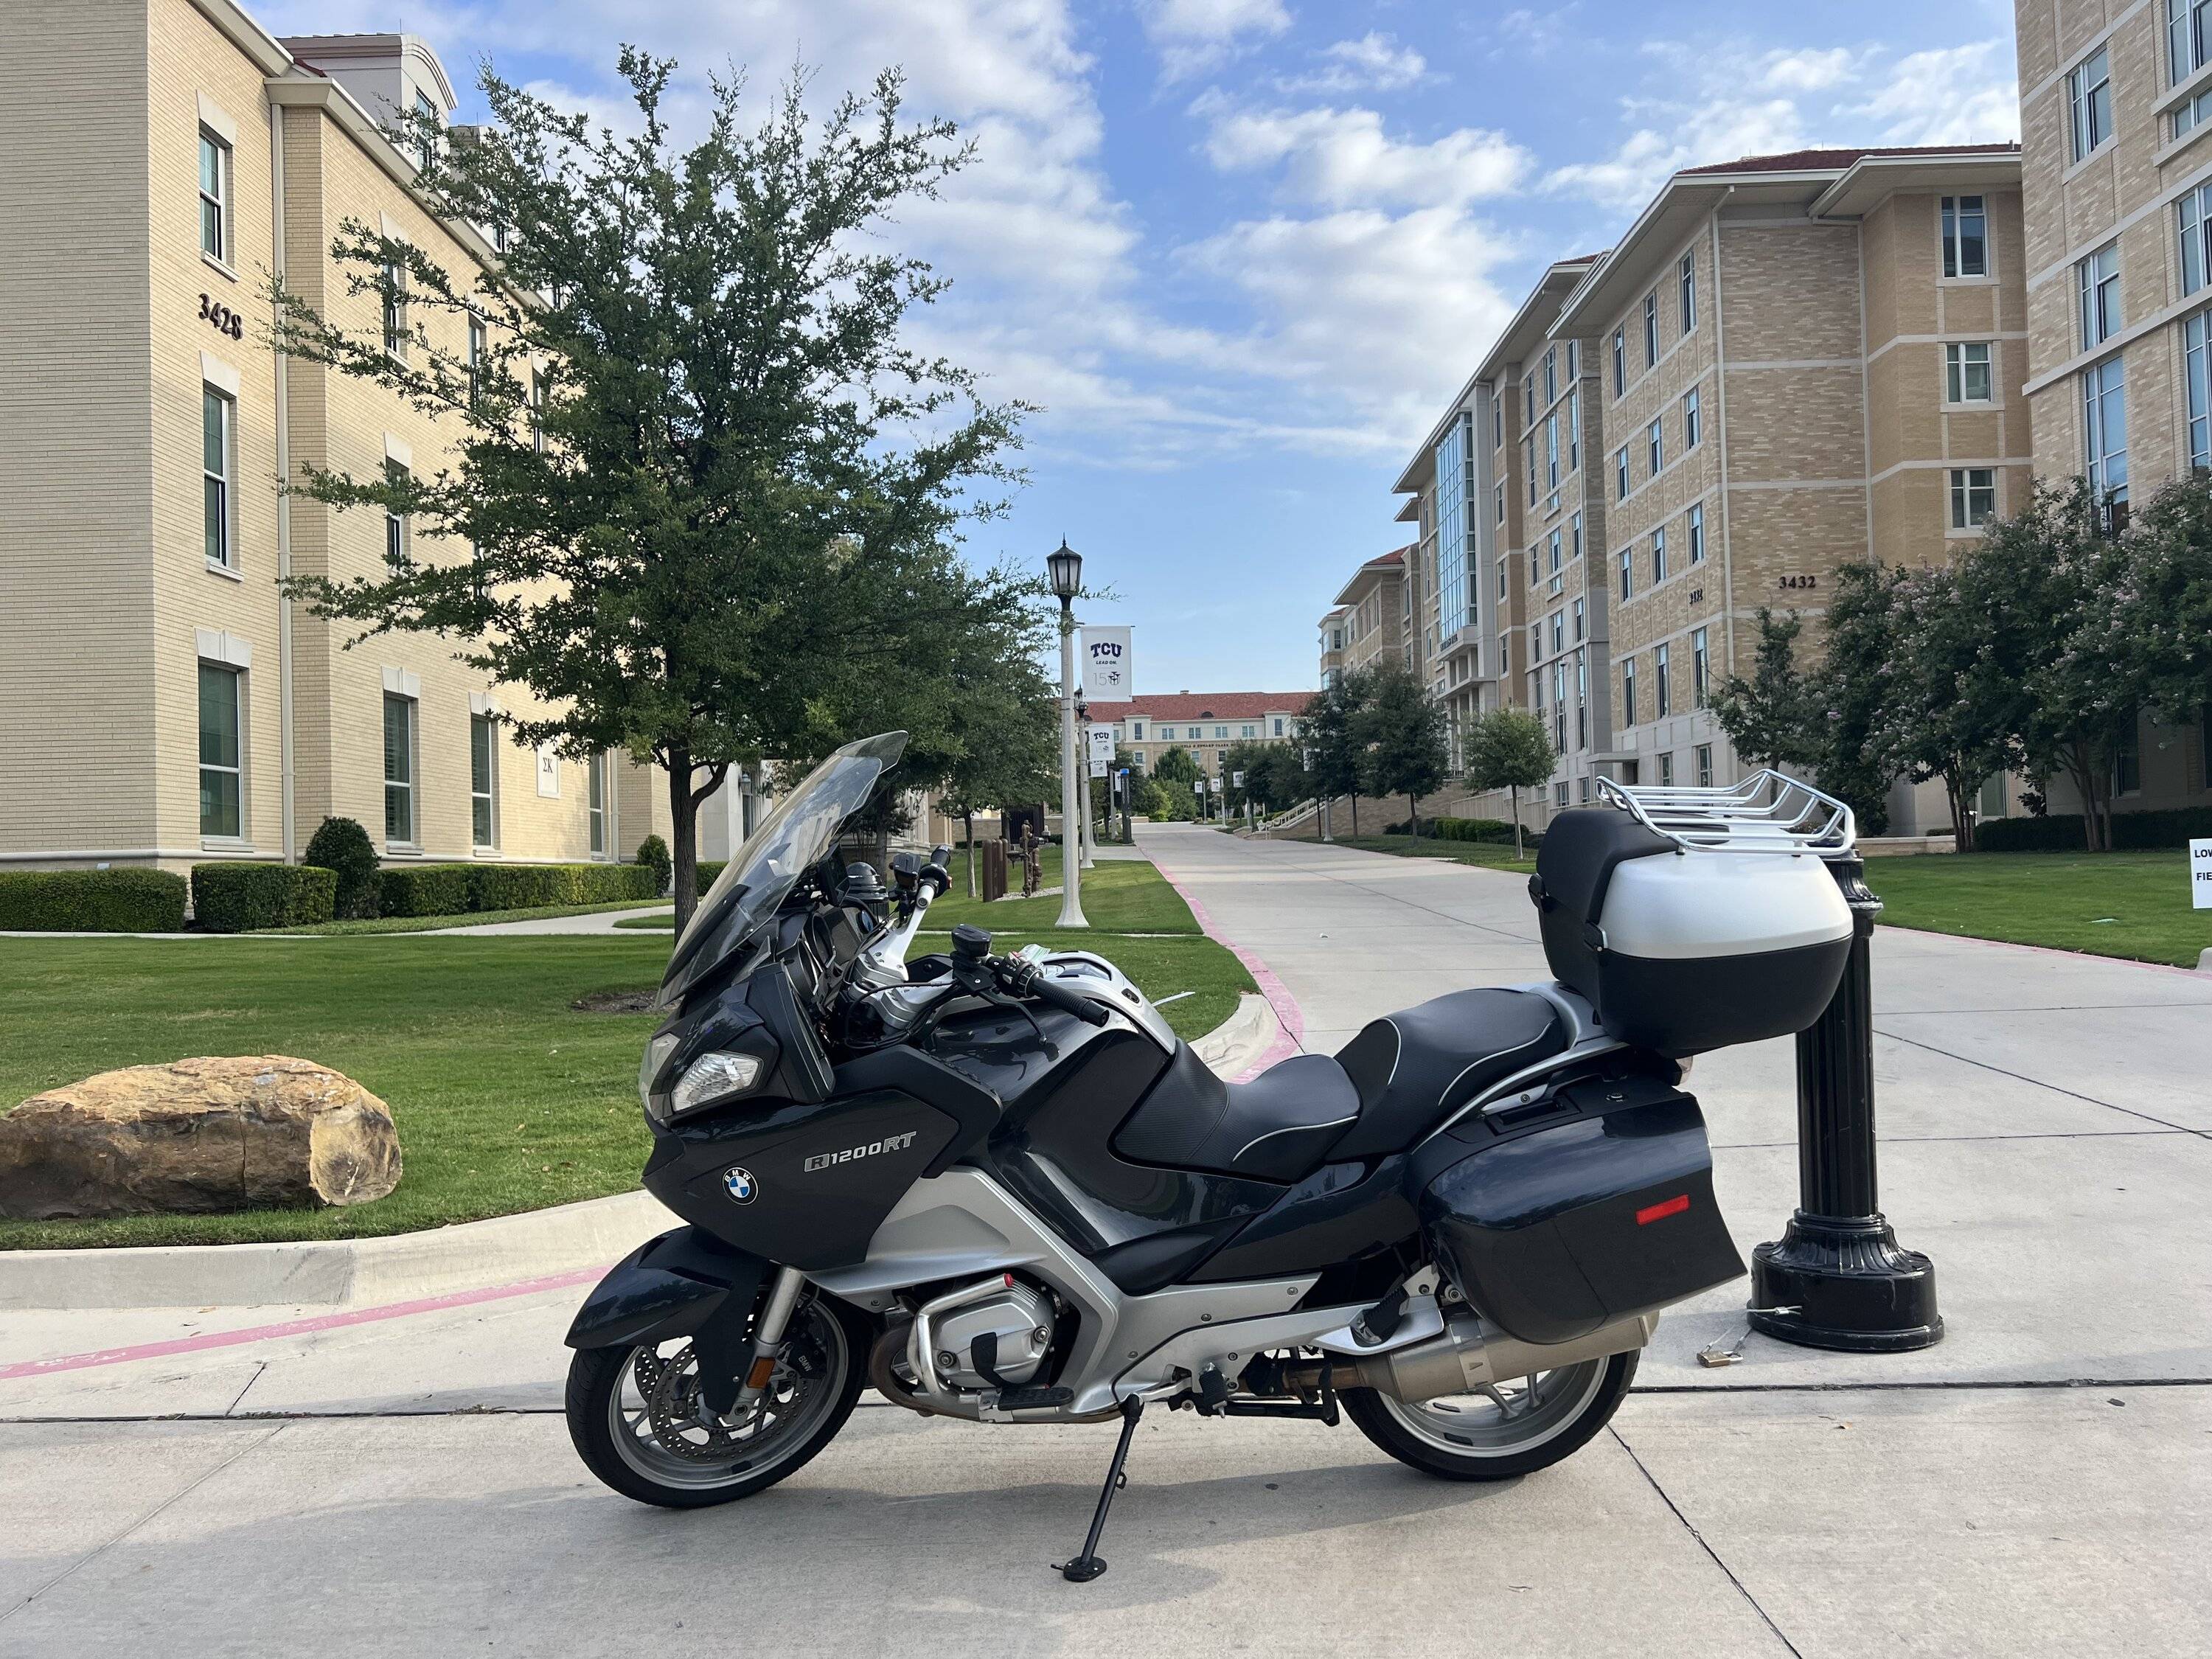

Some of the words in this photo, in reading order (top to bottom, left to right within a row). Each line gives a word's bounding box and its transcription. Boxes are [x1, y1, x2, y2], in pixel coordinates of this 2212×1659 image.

[198, 293, 243, 341] 3428
[1778, 576, 1816, 588] 3432
[1091, 642, 1121, 658] TCU
[804, 1131, 917, 1172] R1200RT
[725, 1169, 751, 1182] BMW
[799, 1355, 813, 1371] BMW
